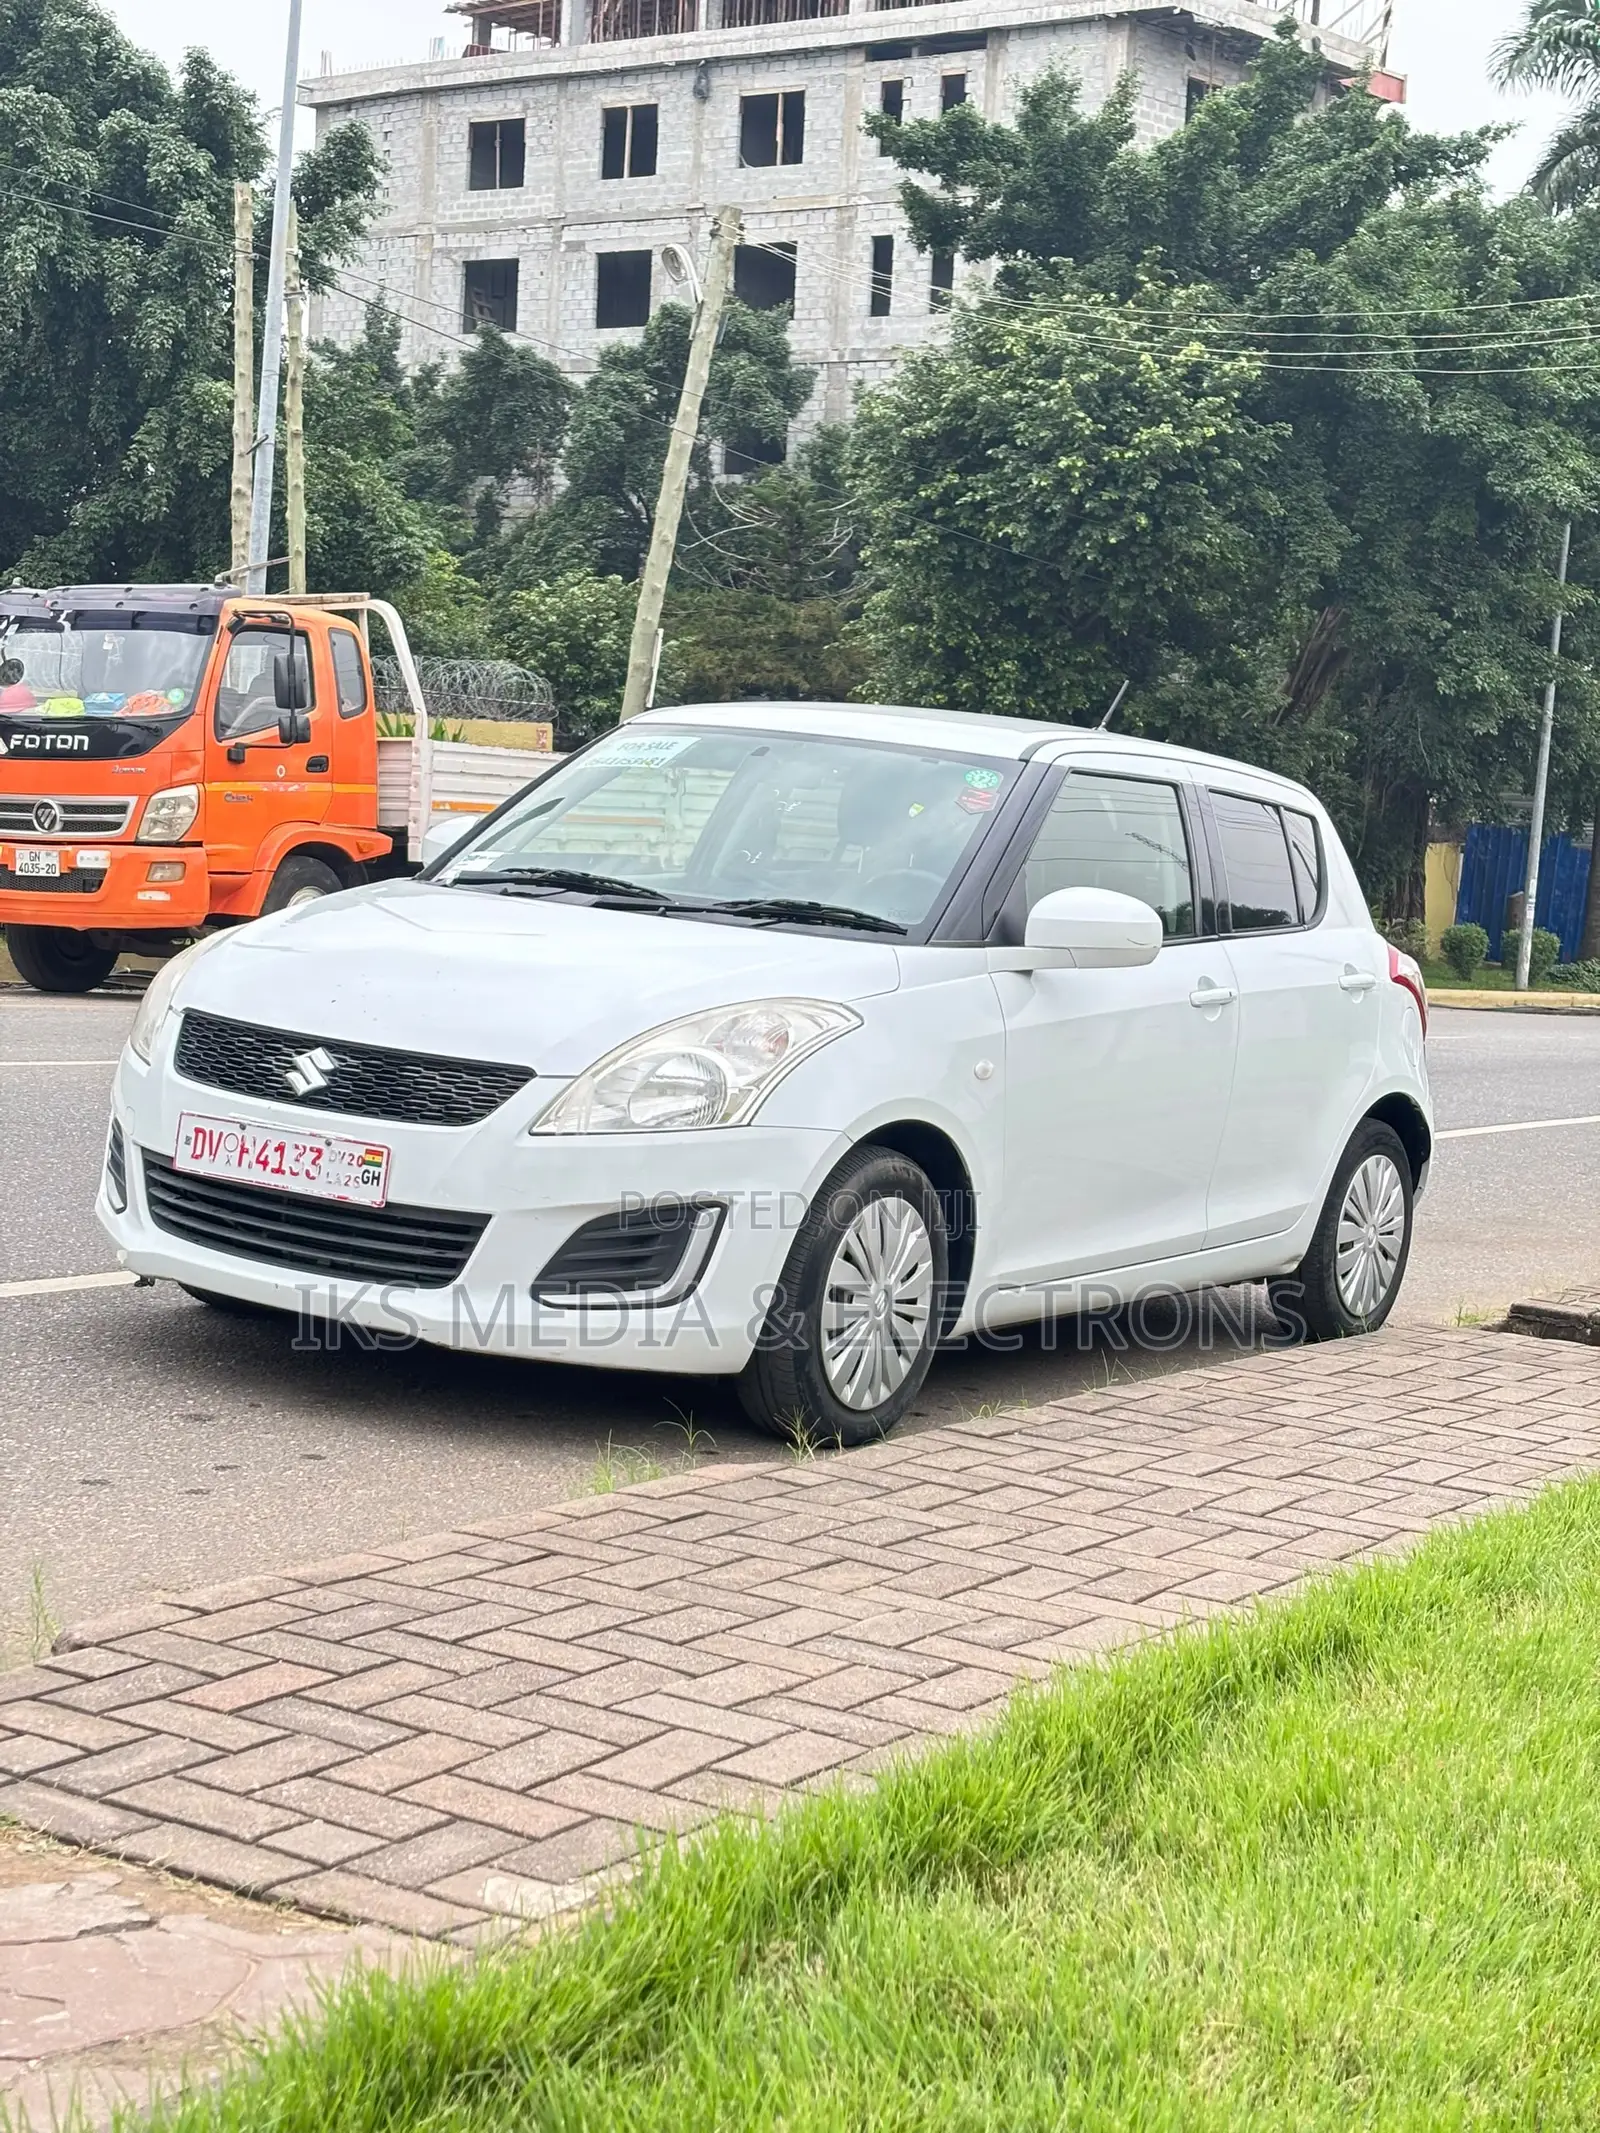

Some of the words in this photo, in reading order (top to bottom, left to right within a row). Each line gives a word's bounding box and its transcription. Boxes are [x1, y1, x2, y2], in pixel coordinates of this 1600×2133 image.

[10, 734, 89, 751] FOTON
[29, 851, 40, 862] GN
[19, 863, 57, 875] 4035-20
[361, 1168, 381, 1187] GH
